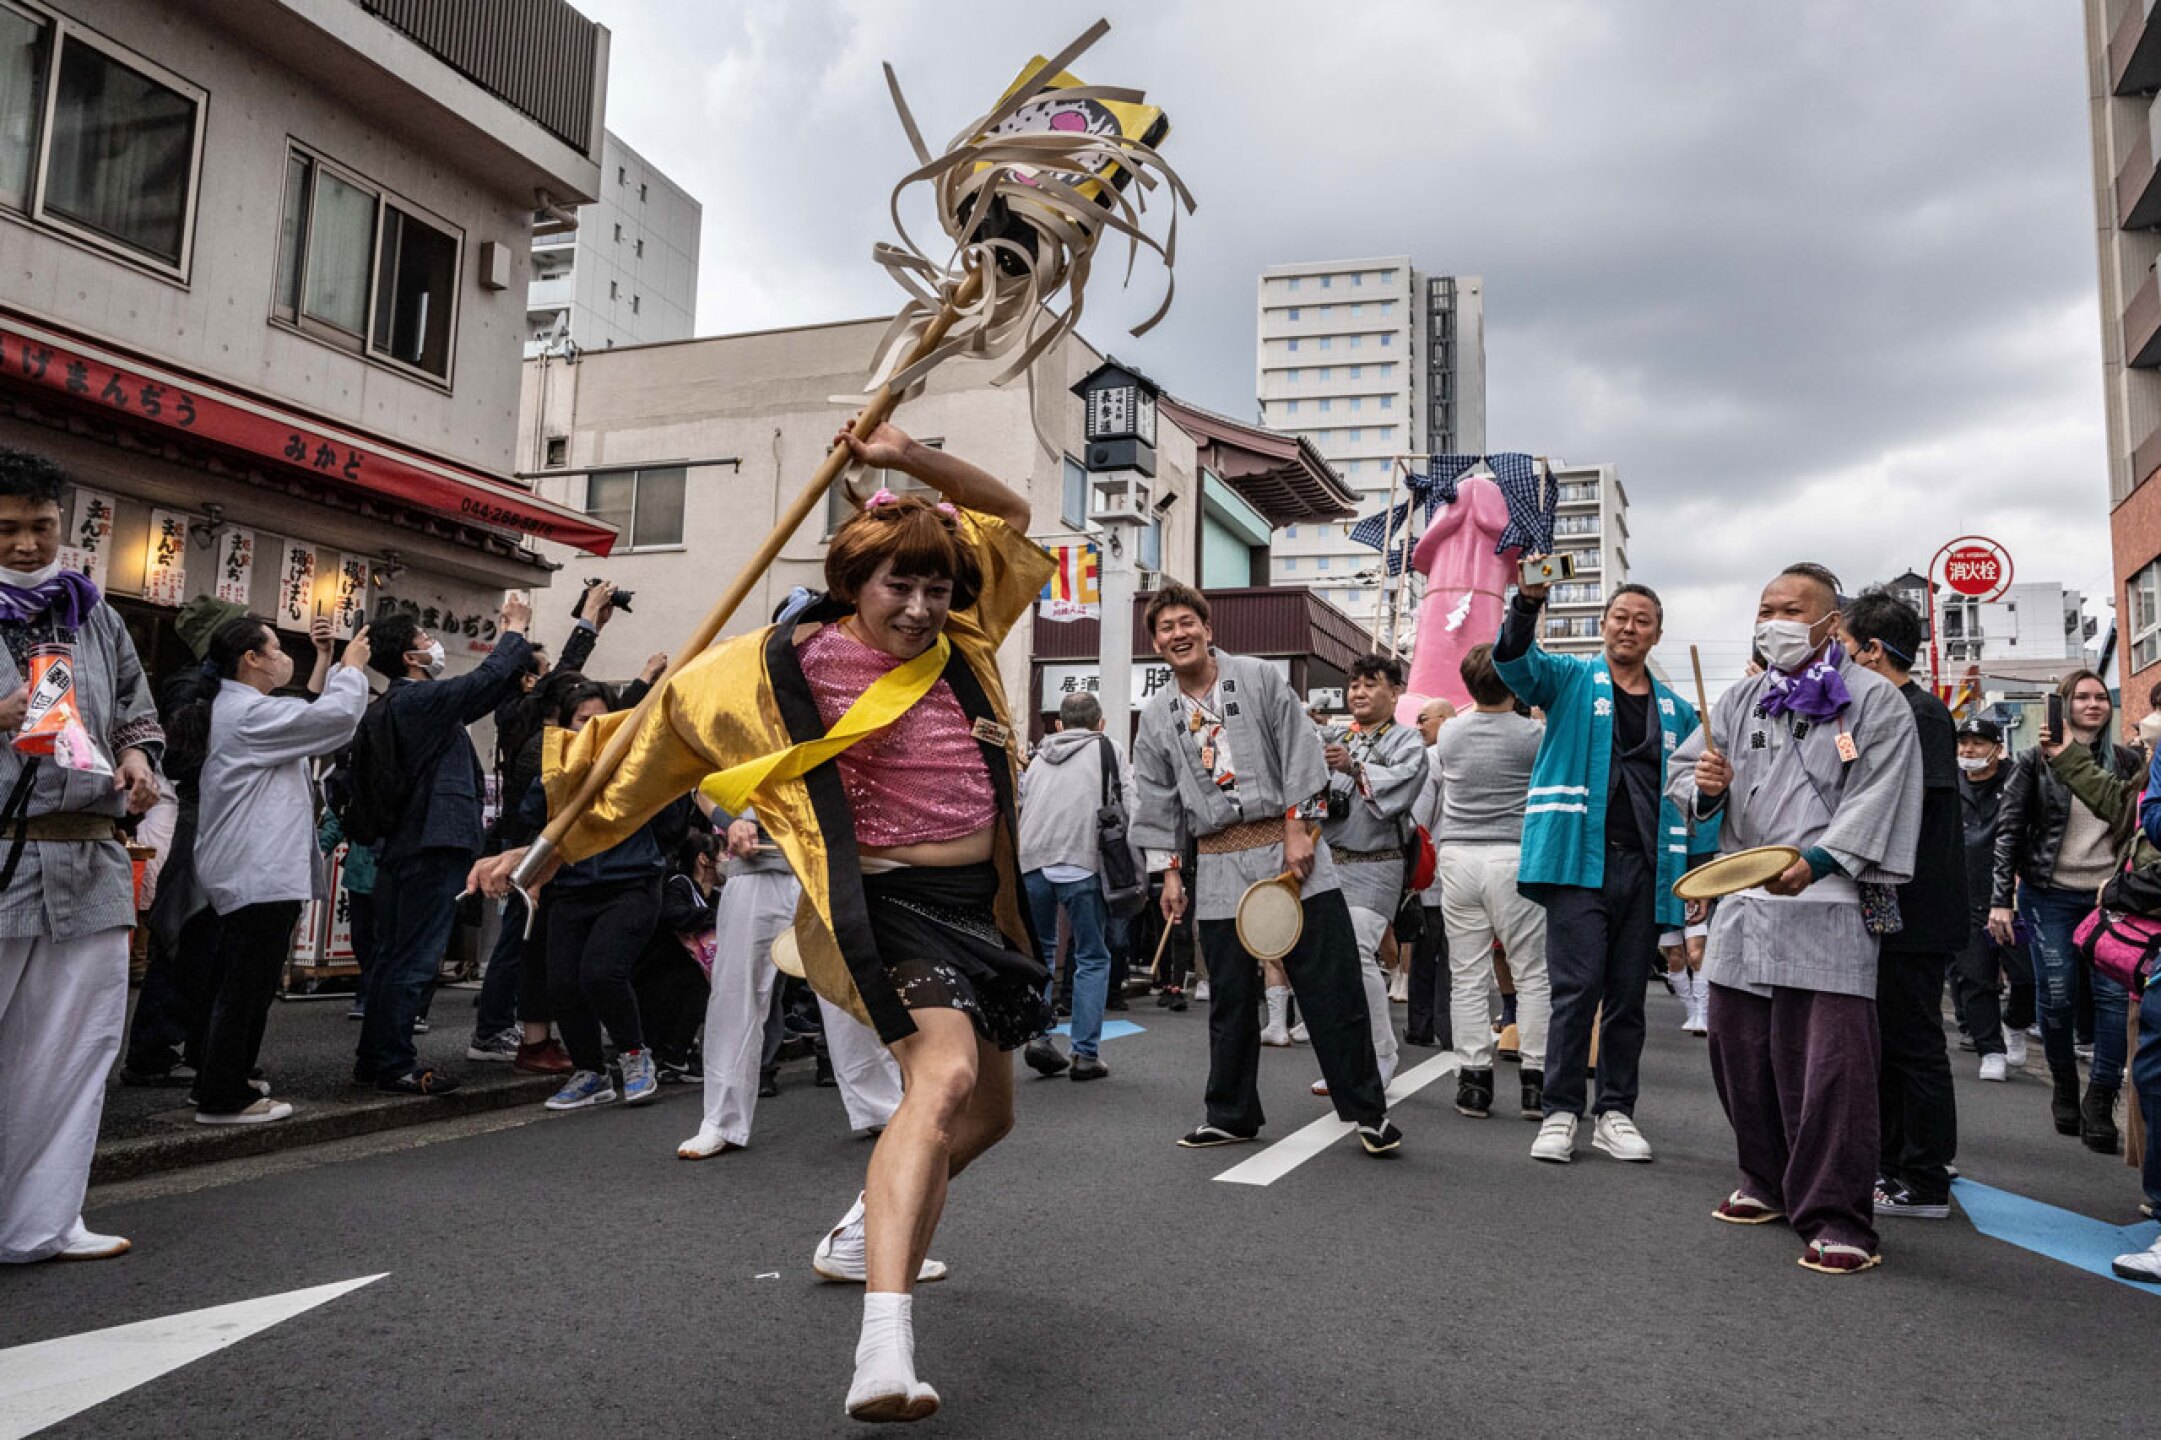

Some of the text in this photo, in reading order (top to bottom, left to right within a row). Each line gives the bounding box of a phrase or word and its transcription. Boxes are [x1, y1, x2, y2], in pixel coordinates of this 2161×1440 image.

[0, 335, 197, 427] げまんぢう
[284, 434, 365, 480] みかど
[1949, 560, 1997, 582] 消火栓
